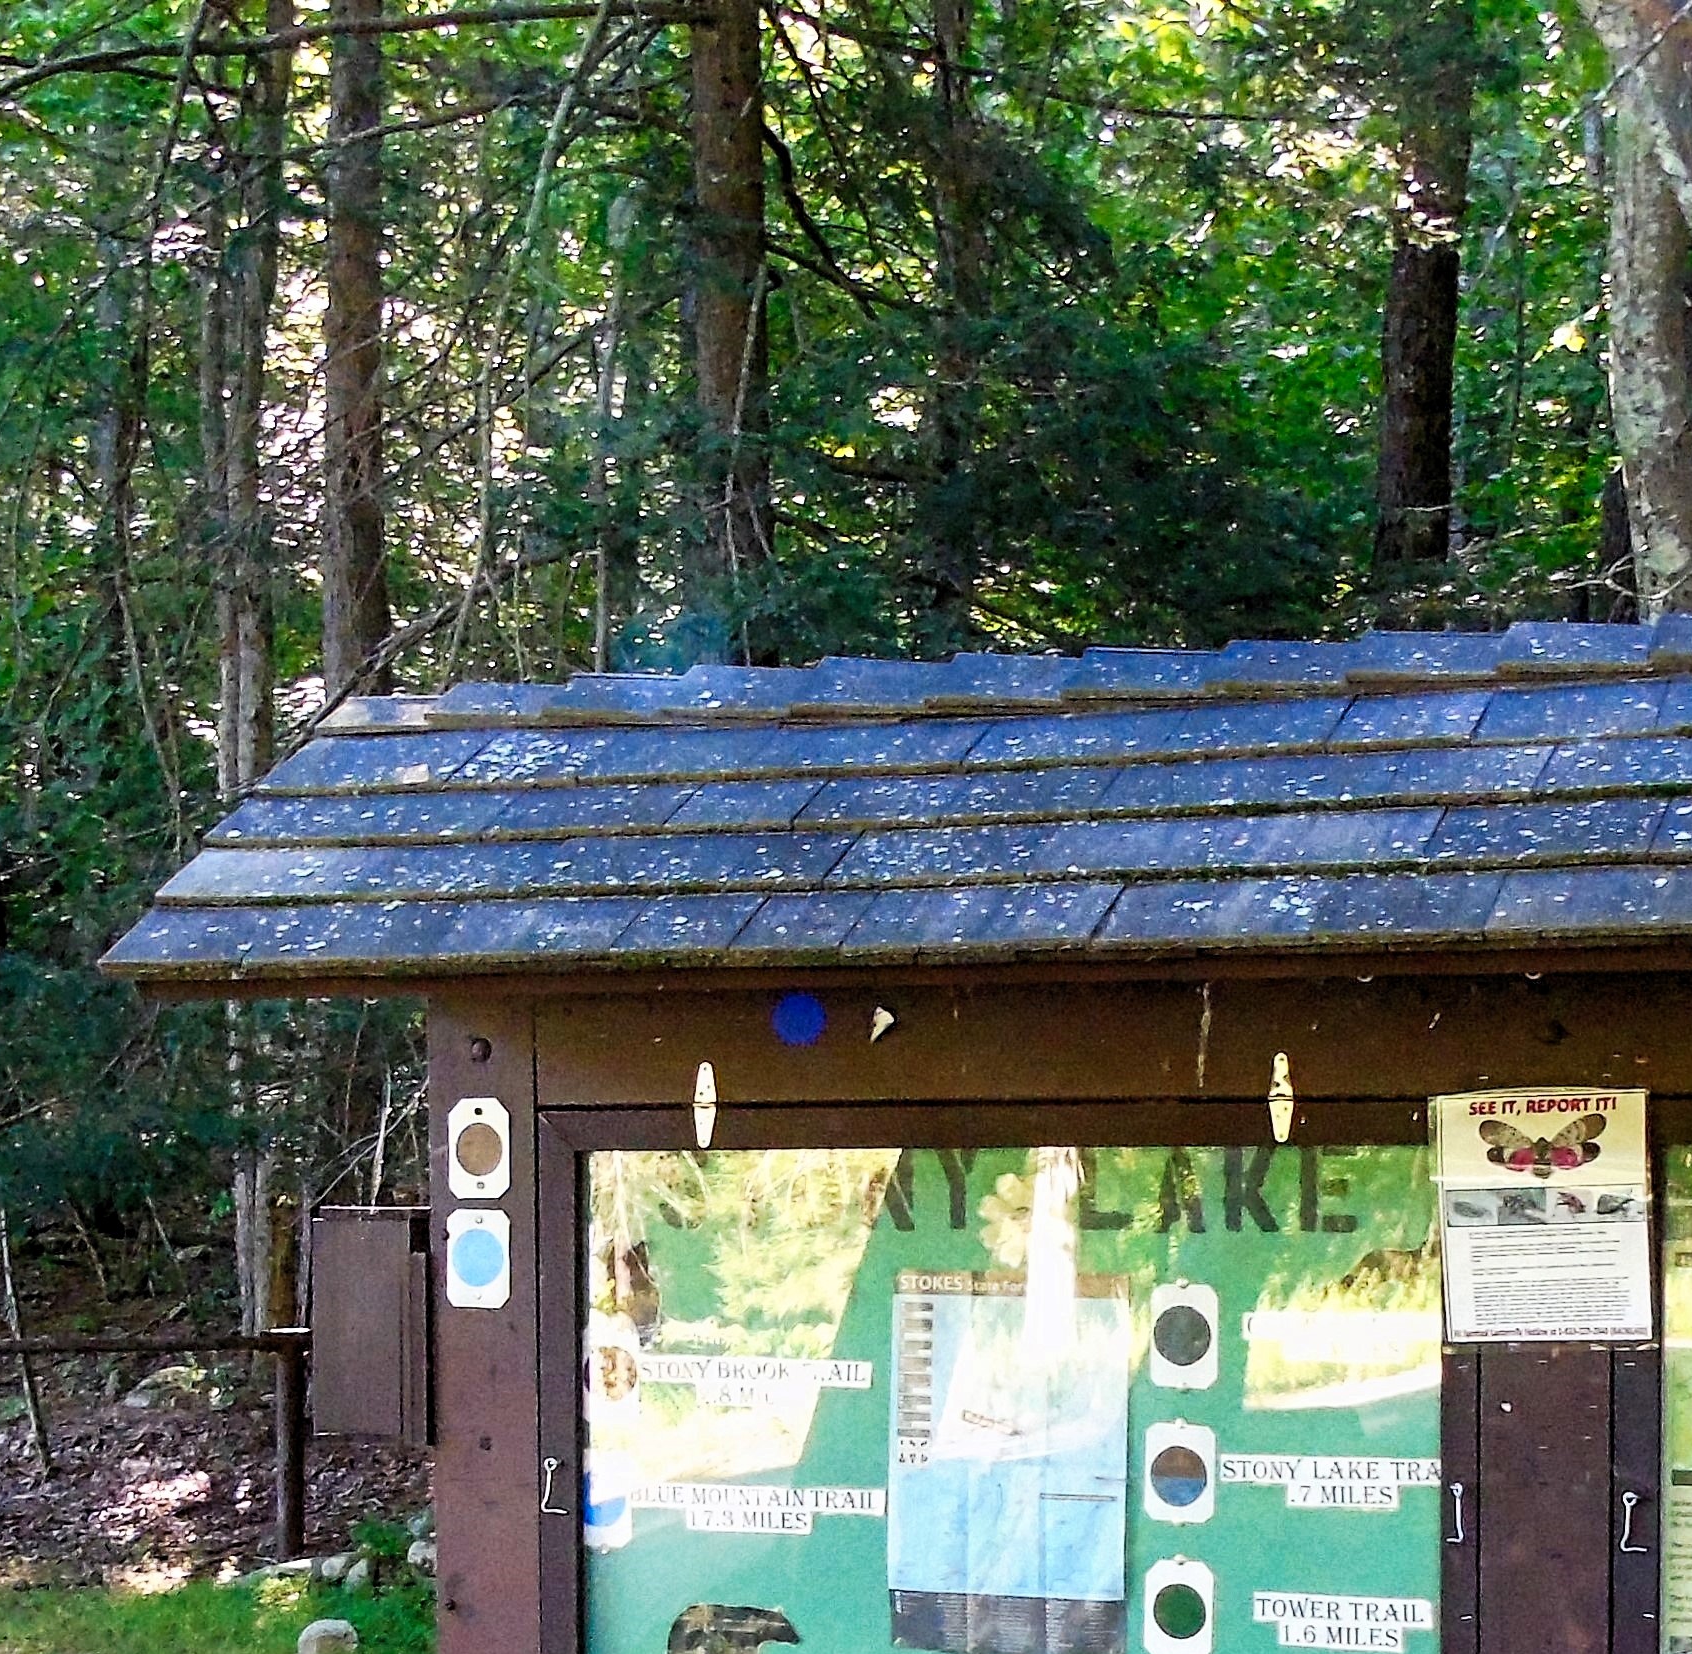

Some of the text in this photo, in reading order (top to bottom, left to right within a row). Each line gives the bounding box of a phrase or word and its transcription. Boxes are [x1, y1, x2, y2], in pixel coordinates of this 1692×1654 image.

[1469, 1097, 1617, 1117] SEE IT, REPORT IT!
[899, 1274, 963, 1291] STOKES
[641, 1358, 712, 1379] STONY
[717, 1361, 790, 1381] BROOK
[1222, 1458, 1442, 1482] STONY LAKE TRA
[629, 1485, 876, 1510] BLUE MOUNTAIN TRAIL
[1290, 1485, 1393, 1505] .7 MILES
[690, 1509, 808, 1530] 17.3 MILES
[1255, 1597, 1425, 1623] TOWER TRAIL
[1284, 1624, 1399, 1648] 1.6 MILES
